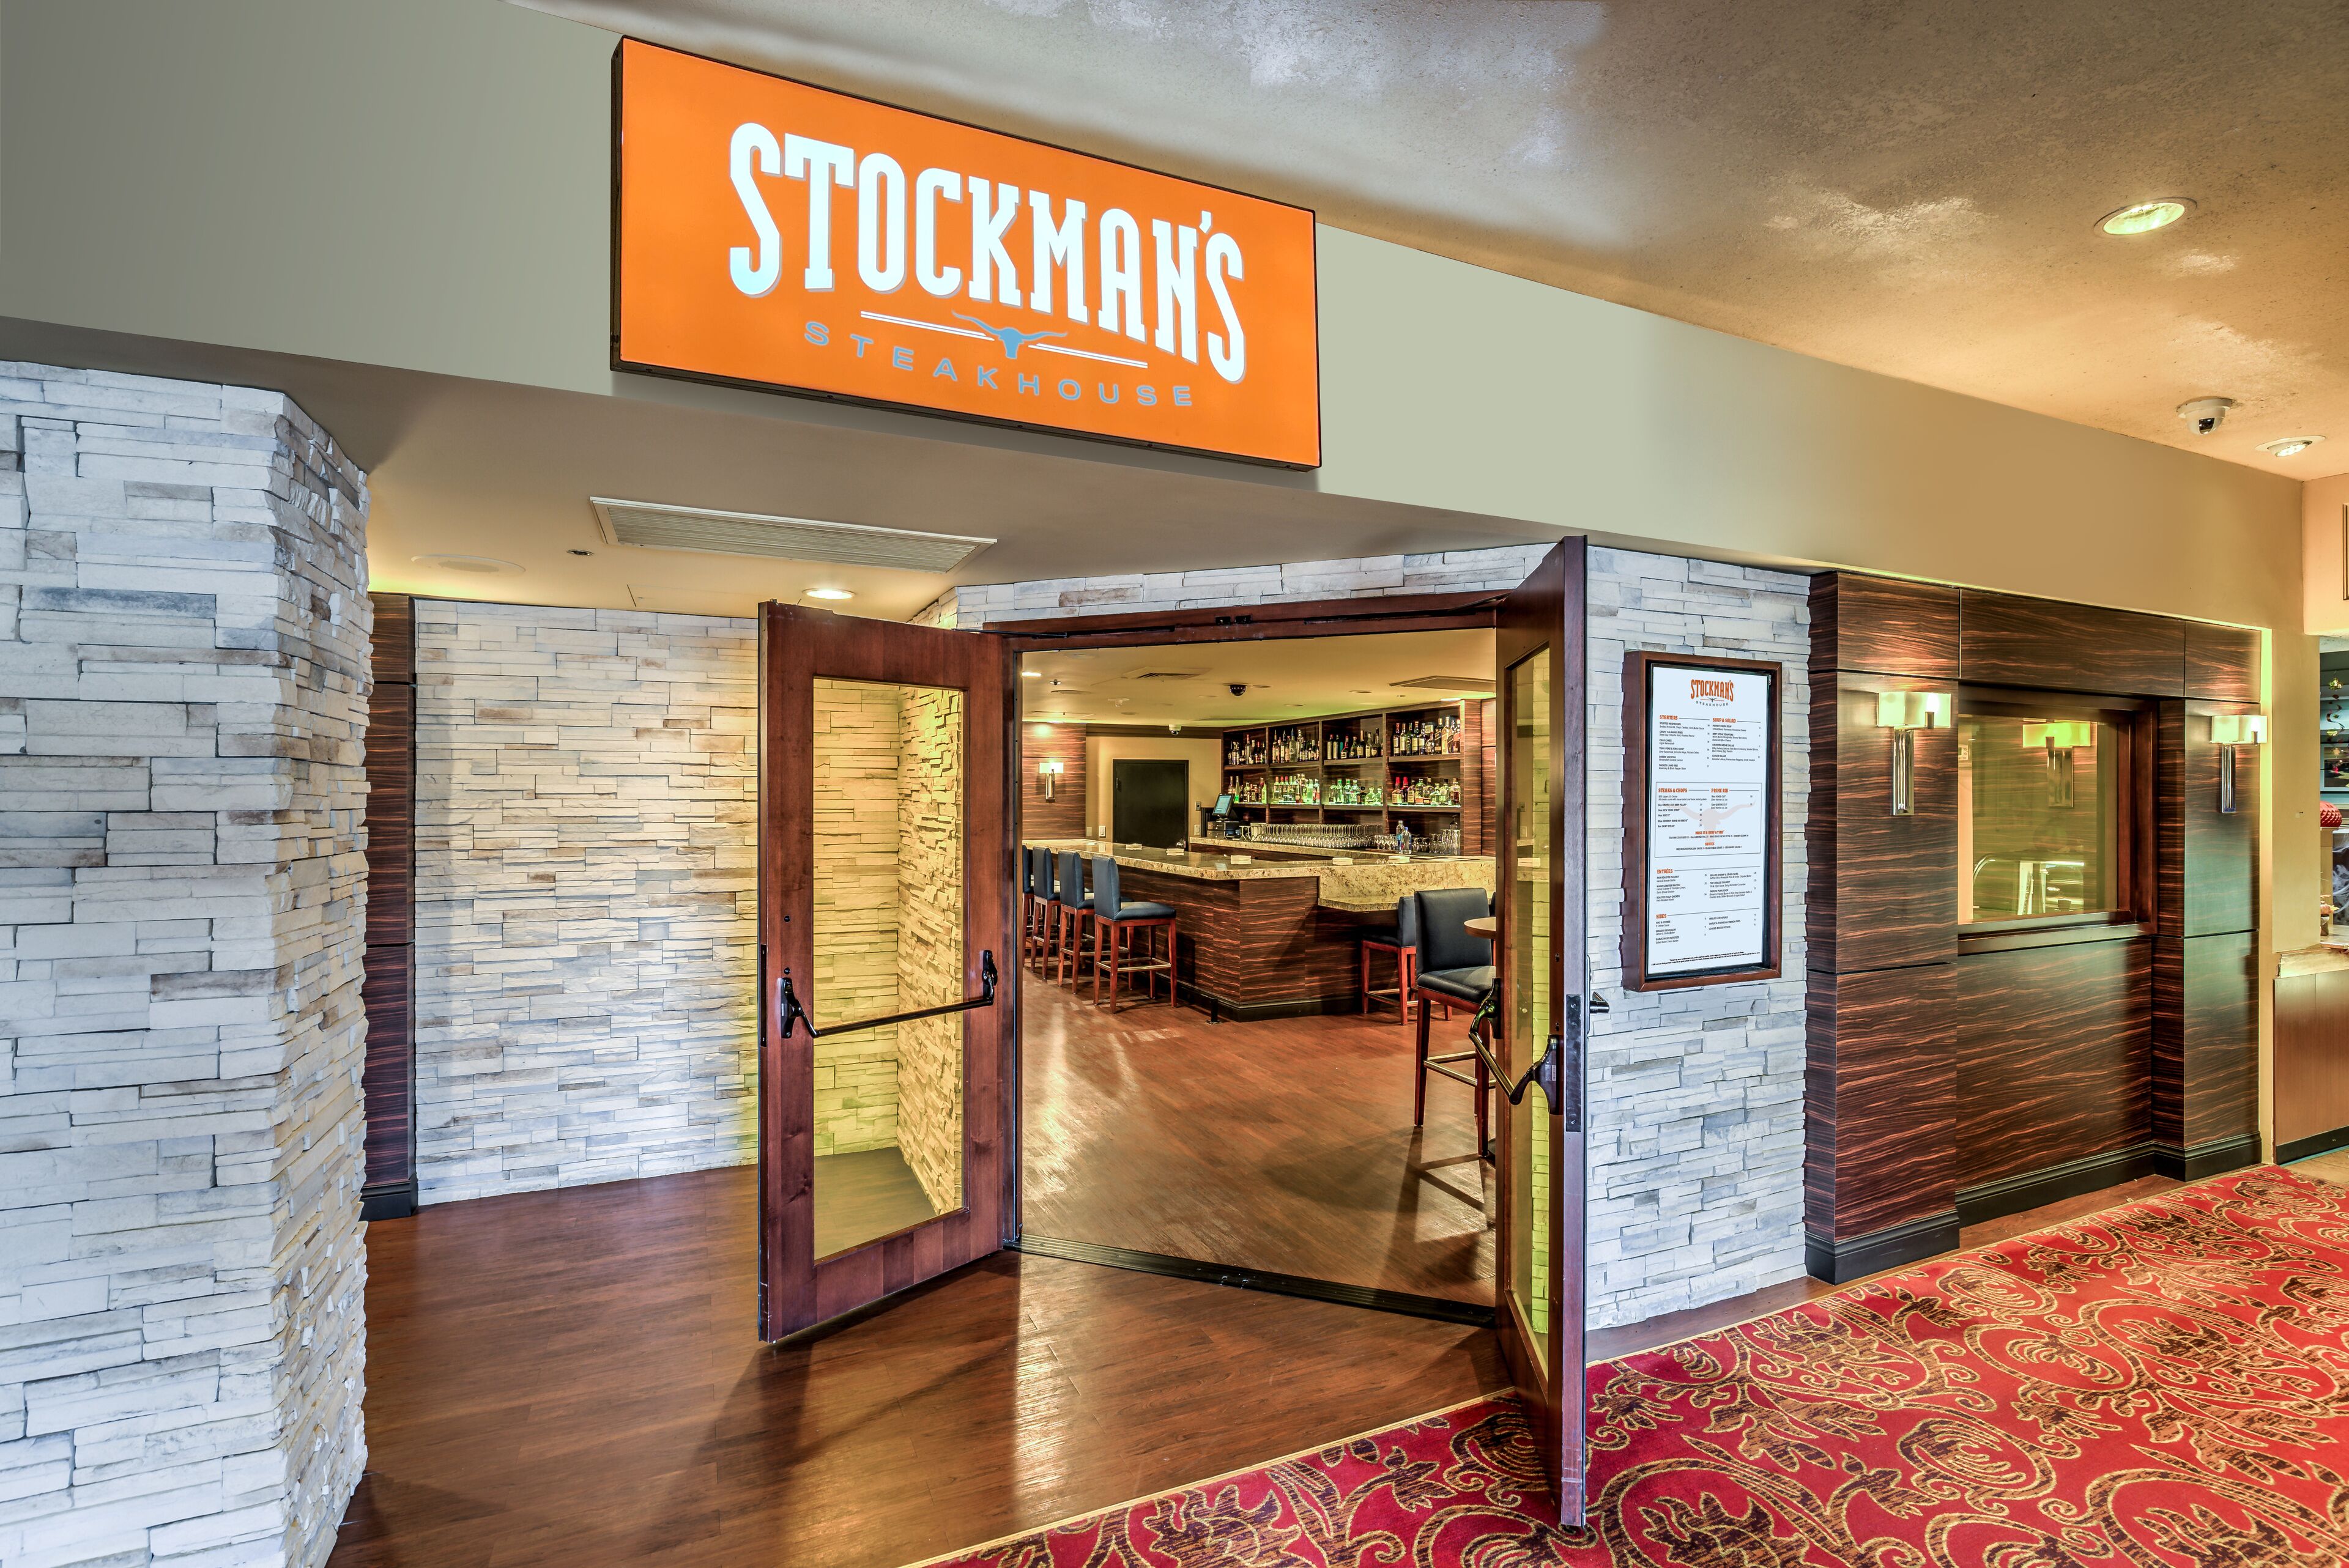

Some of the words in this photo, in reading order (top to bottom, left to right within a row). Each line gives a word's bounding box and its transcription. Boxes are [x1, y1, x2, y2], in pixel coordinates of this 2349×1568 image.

[730, 122, 1245, 383] STOCKMAN'S
[806, 320, 1193, 407] STEAKHOUSE
[1691, 679, 1734, 701] STOCKMAN'S
